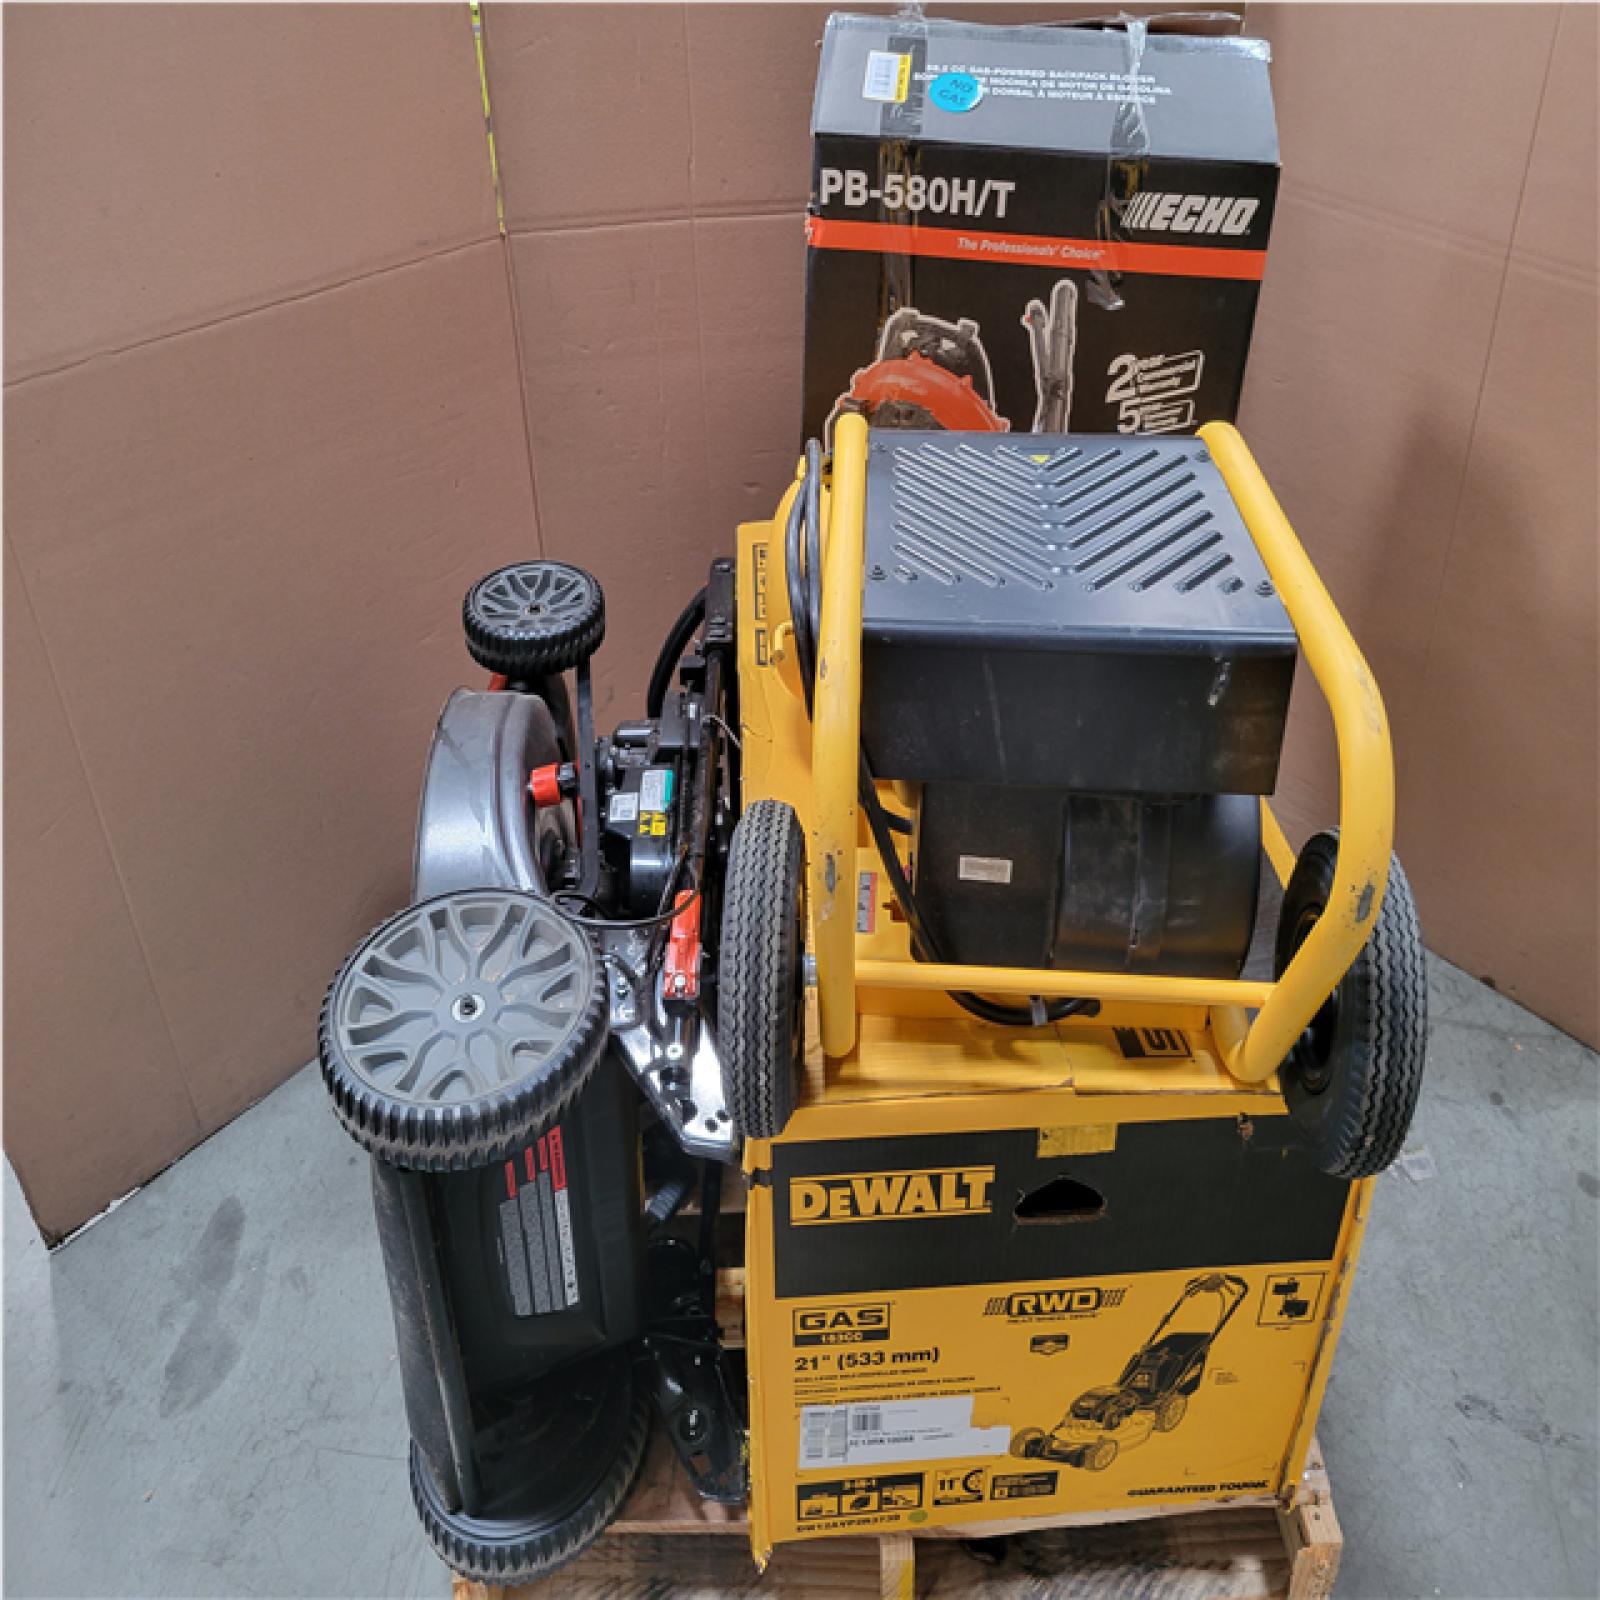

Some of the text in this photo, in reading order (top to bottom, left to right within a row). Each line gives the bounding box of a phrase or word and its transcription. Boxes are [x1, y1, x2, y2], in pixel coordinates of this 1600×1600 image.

[820, 167, 1016, 218] PB-580H/T
[1147, 194, 1260, 235] ECHO
[957, 236, 978, 251] The
[1011, 1289, 1098, 1314] RWD
[799, 1308, 885, 1331] GAS
[836, 1350, 886, 1370] (533
[892, 1346, 940, 1366] mm)
